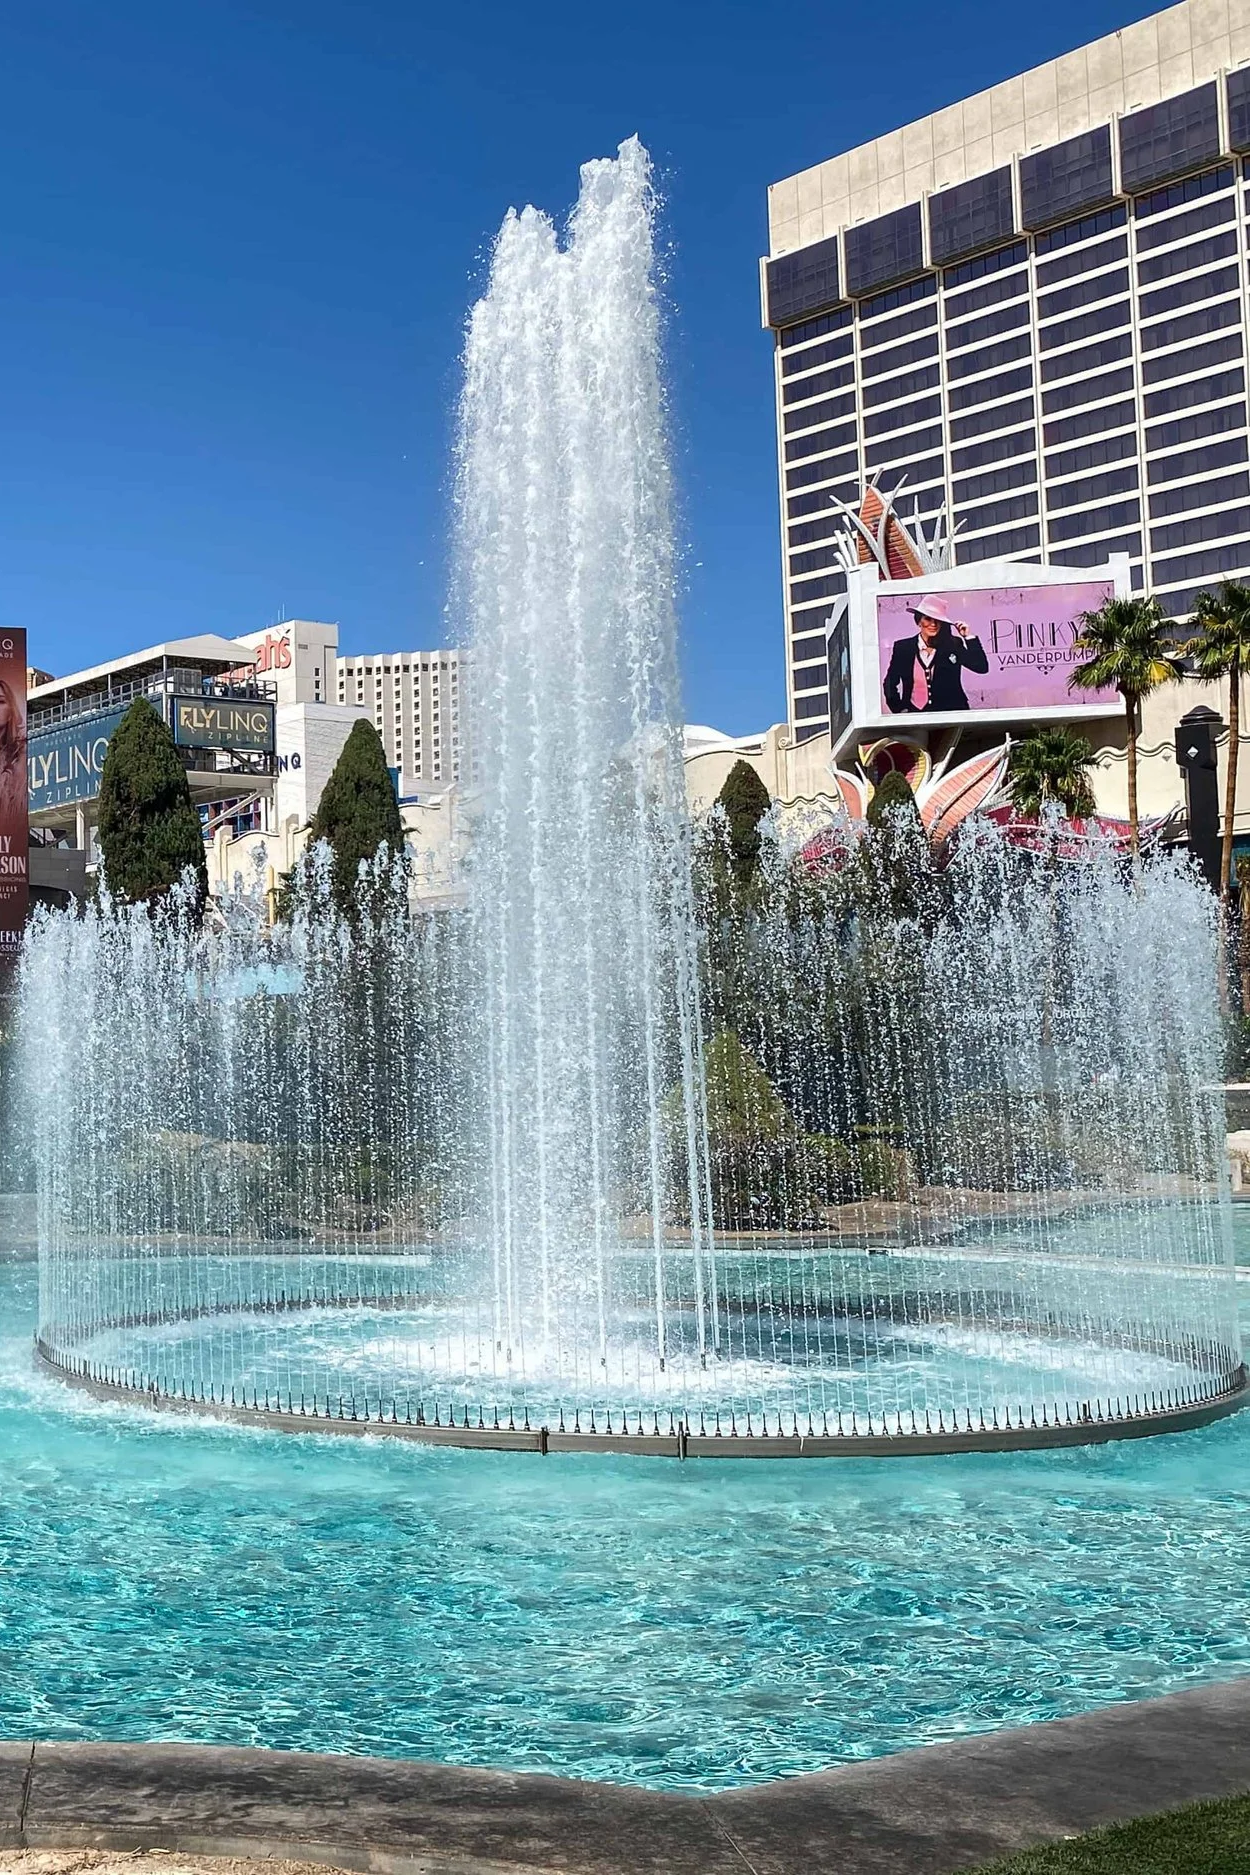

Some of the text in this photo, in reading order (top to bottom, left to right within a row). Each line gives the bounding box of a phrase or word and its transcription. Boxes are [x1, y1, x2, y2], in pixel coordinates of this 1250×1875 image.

[180, 706, 268, 734] FLYLINQ
[208, 731, 268, 744] ZIPLINE
[27, 737, 109, 790] LYLINQ
